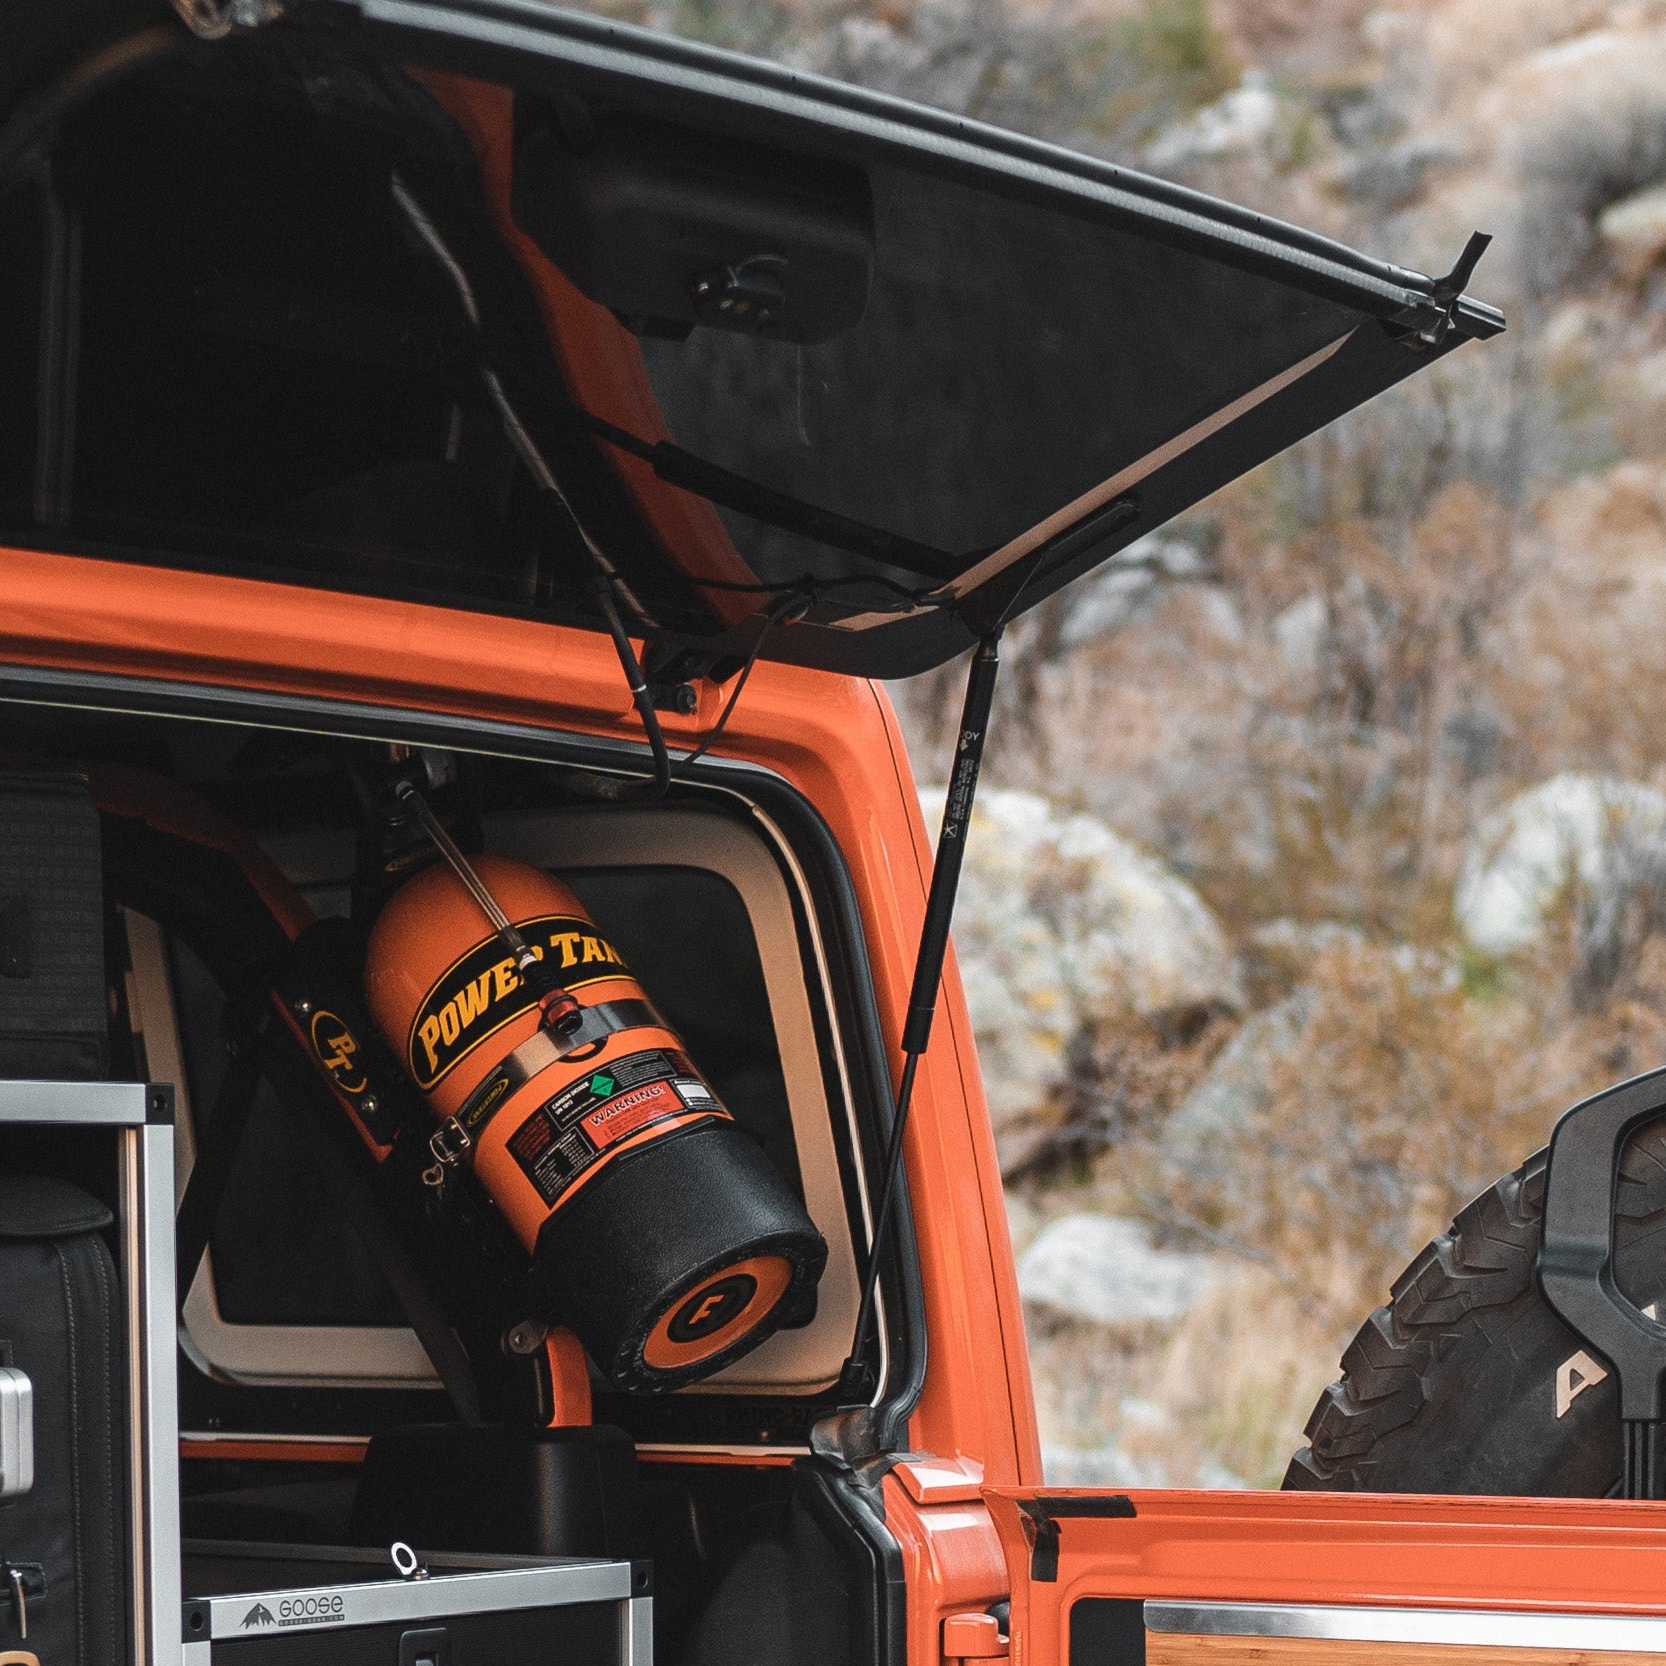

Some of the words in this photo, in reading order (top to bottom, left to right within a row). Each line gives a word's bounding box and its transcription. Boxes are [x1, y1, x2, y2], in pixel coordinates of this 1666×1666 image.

[549, 931, 627, 969] TAN
[590, 1085, 667, 1127] WARNING!
[279, 1595, 344, 1618] GOOSE
